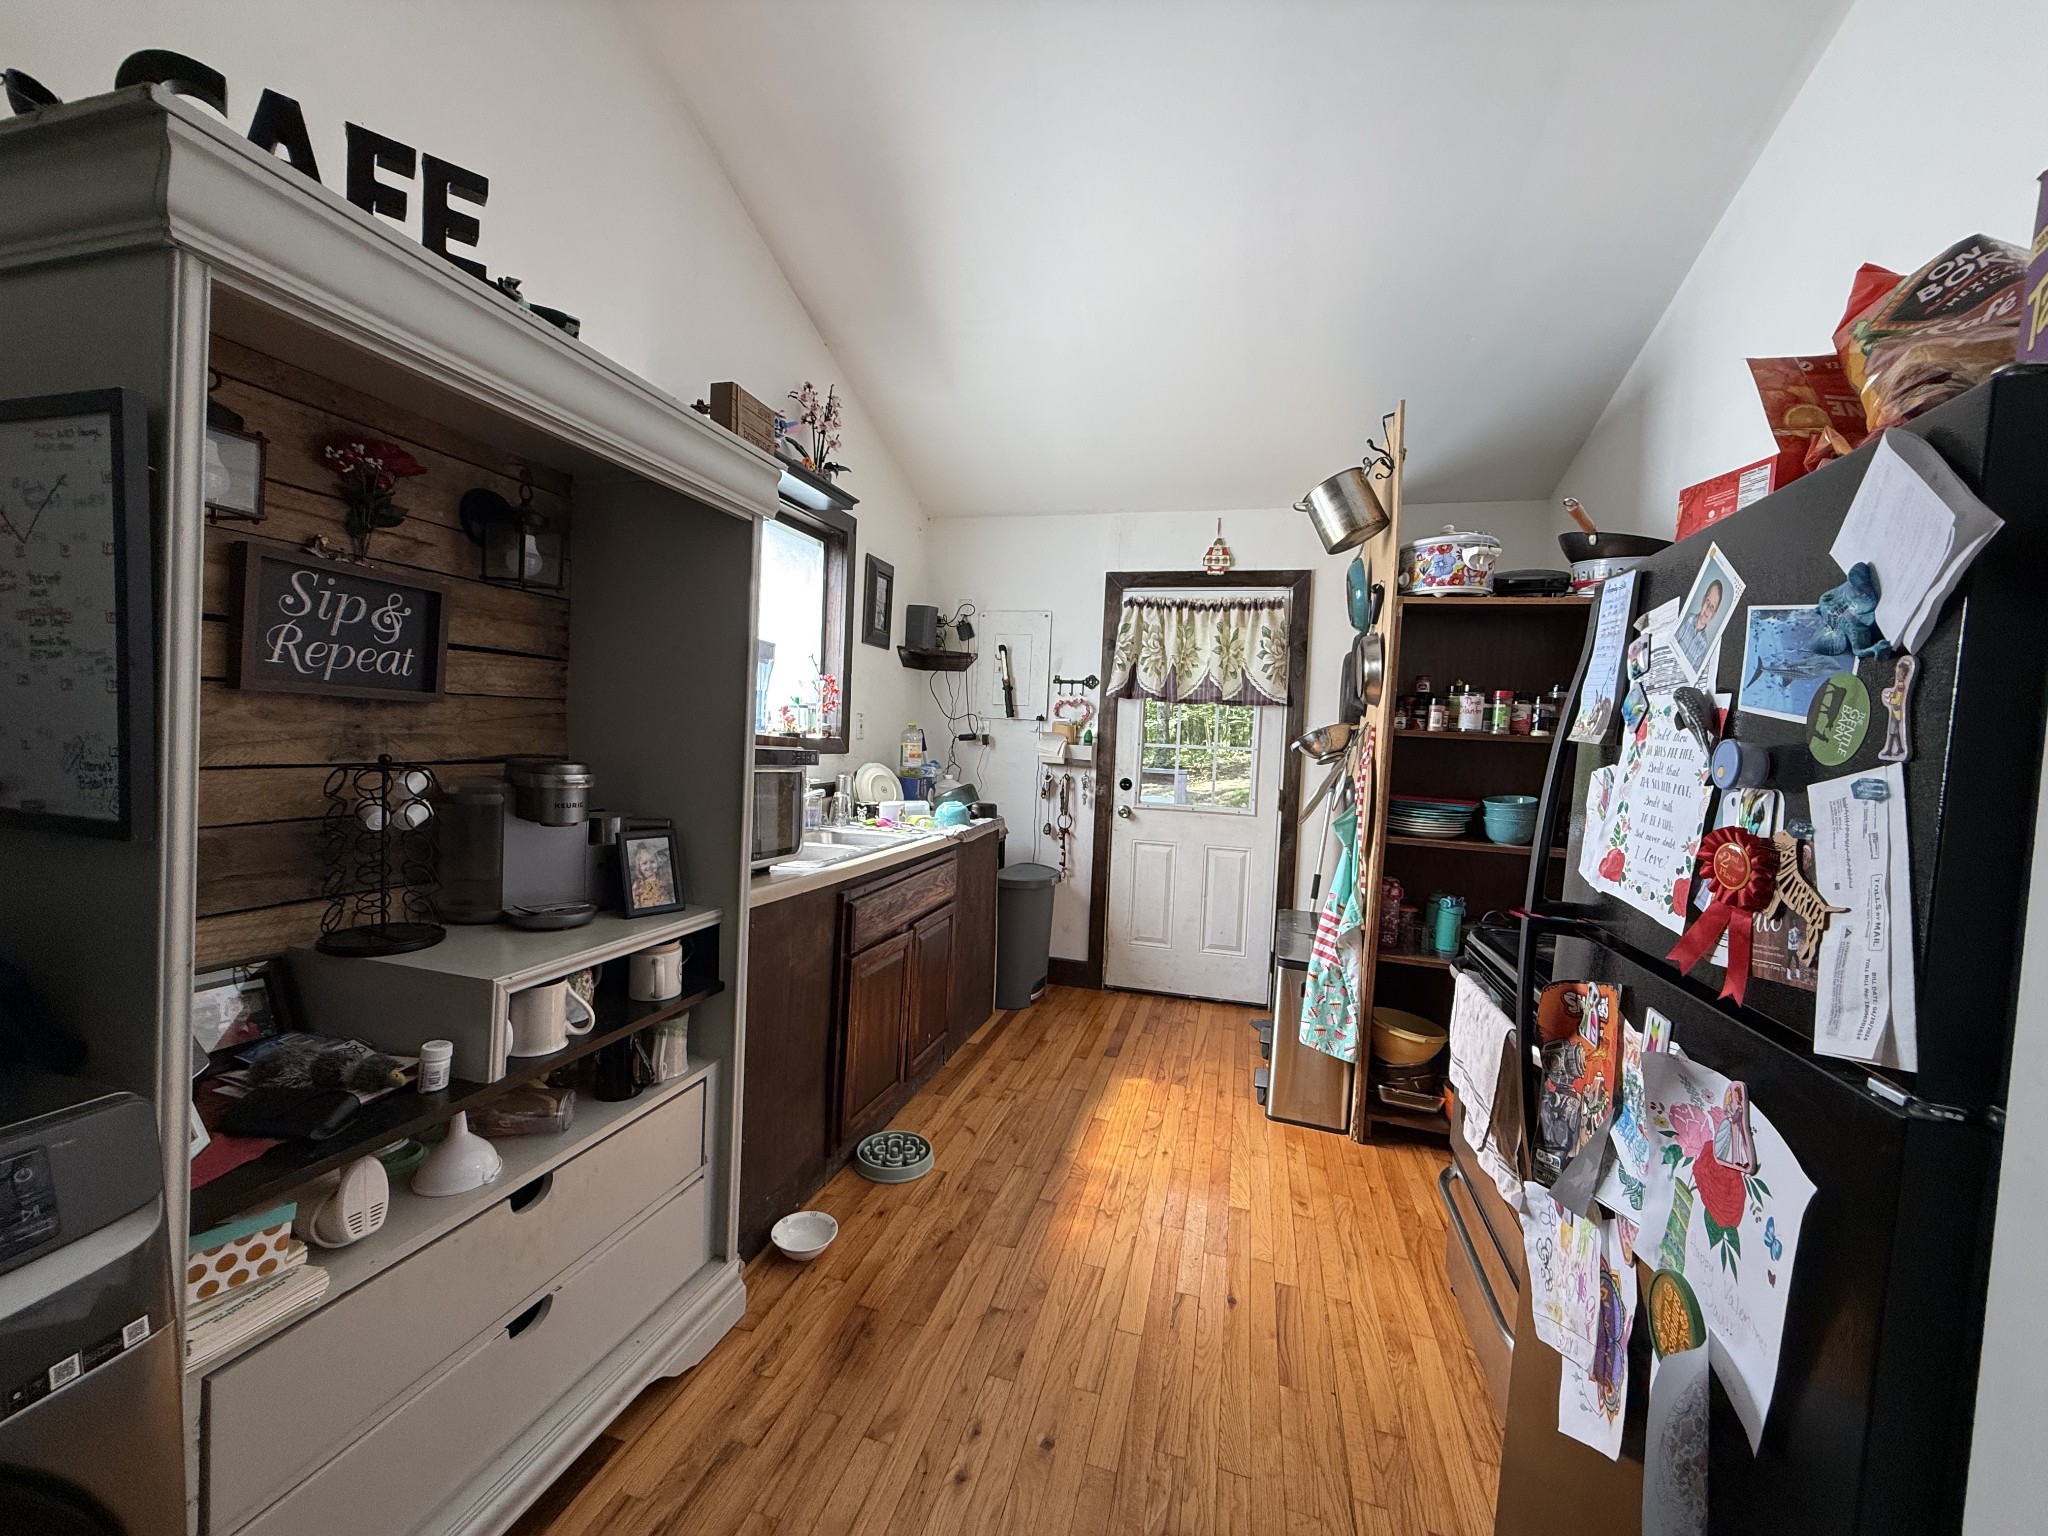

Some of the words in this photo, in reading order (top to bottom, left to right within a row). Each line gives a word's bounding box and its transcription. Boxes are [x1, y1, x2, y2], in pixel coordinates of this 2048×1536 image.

[1928, 245, 1982, 281] ON
[278, 570, 368, 637] Sip
[370, 592, 412, 645] &
[264, 619, 415, 681] Repeat
[1832, 704, 1852, 741] BARN
[1836, 708, 1859, 758] GENTLE
[1857, 712, 1866, 727] THE
[554, 801, 584, 809] KEURIG
[1719, 851, 1739, 869] 2nd
[1719, 867, 1737, 883] Place
[1784, 872, 1825, 930] TERRIER
[1873, 877, 1882, 912] TOLLS
[1872, 922, 1882, 947] MAIL
